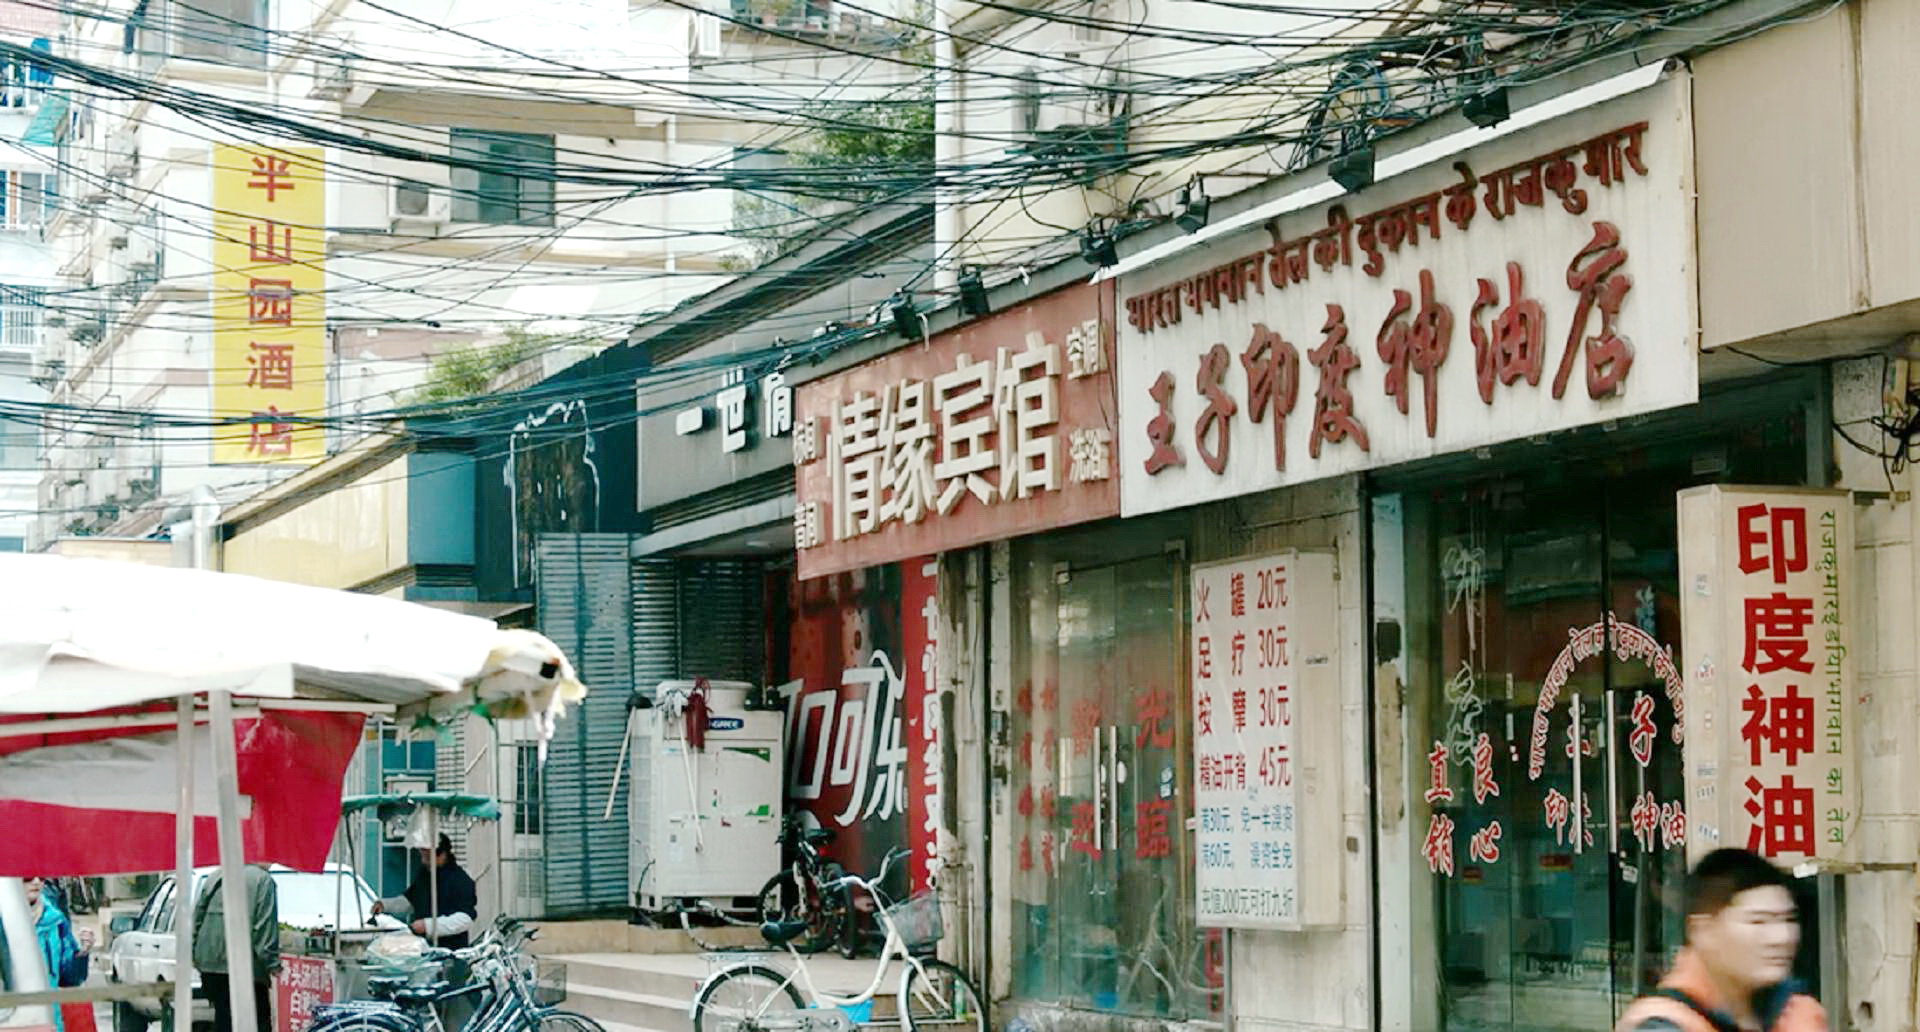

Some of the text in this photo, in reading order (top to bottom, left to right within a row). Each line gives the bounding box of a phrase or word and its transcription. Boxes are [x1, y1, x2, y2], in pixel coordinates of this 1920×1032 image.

[246, 155, 295, 457] 半山园酒店
[1143, 220, 1635, 475] 王子印度神油店
[827, 331, 1062, 543] 情缘宾馆
[1256, 566, 1289, 609] 20元
[1257, 625, 1289, 669] 30元
[1258, 685, 1291, 727] 30元
[1736, 503, 1817, 858] 印度神油
[1258, 745, 1292, 787] 45元
[1422, 740, 1456, 878] 直销
[1470, 734, 1503, 866] 良心
